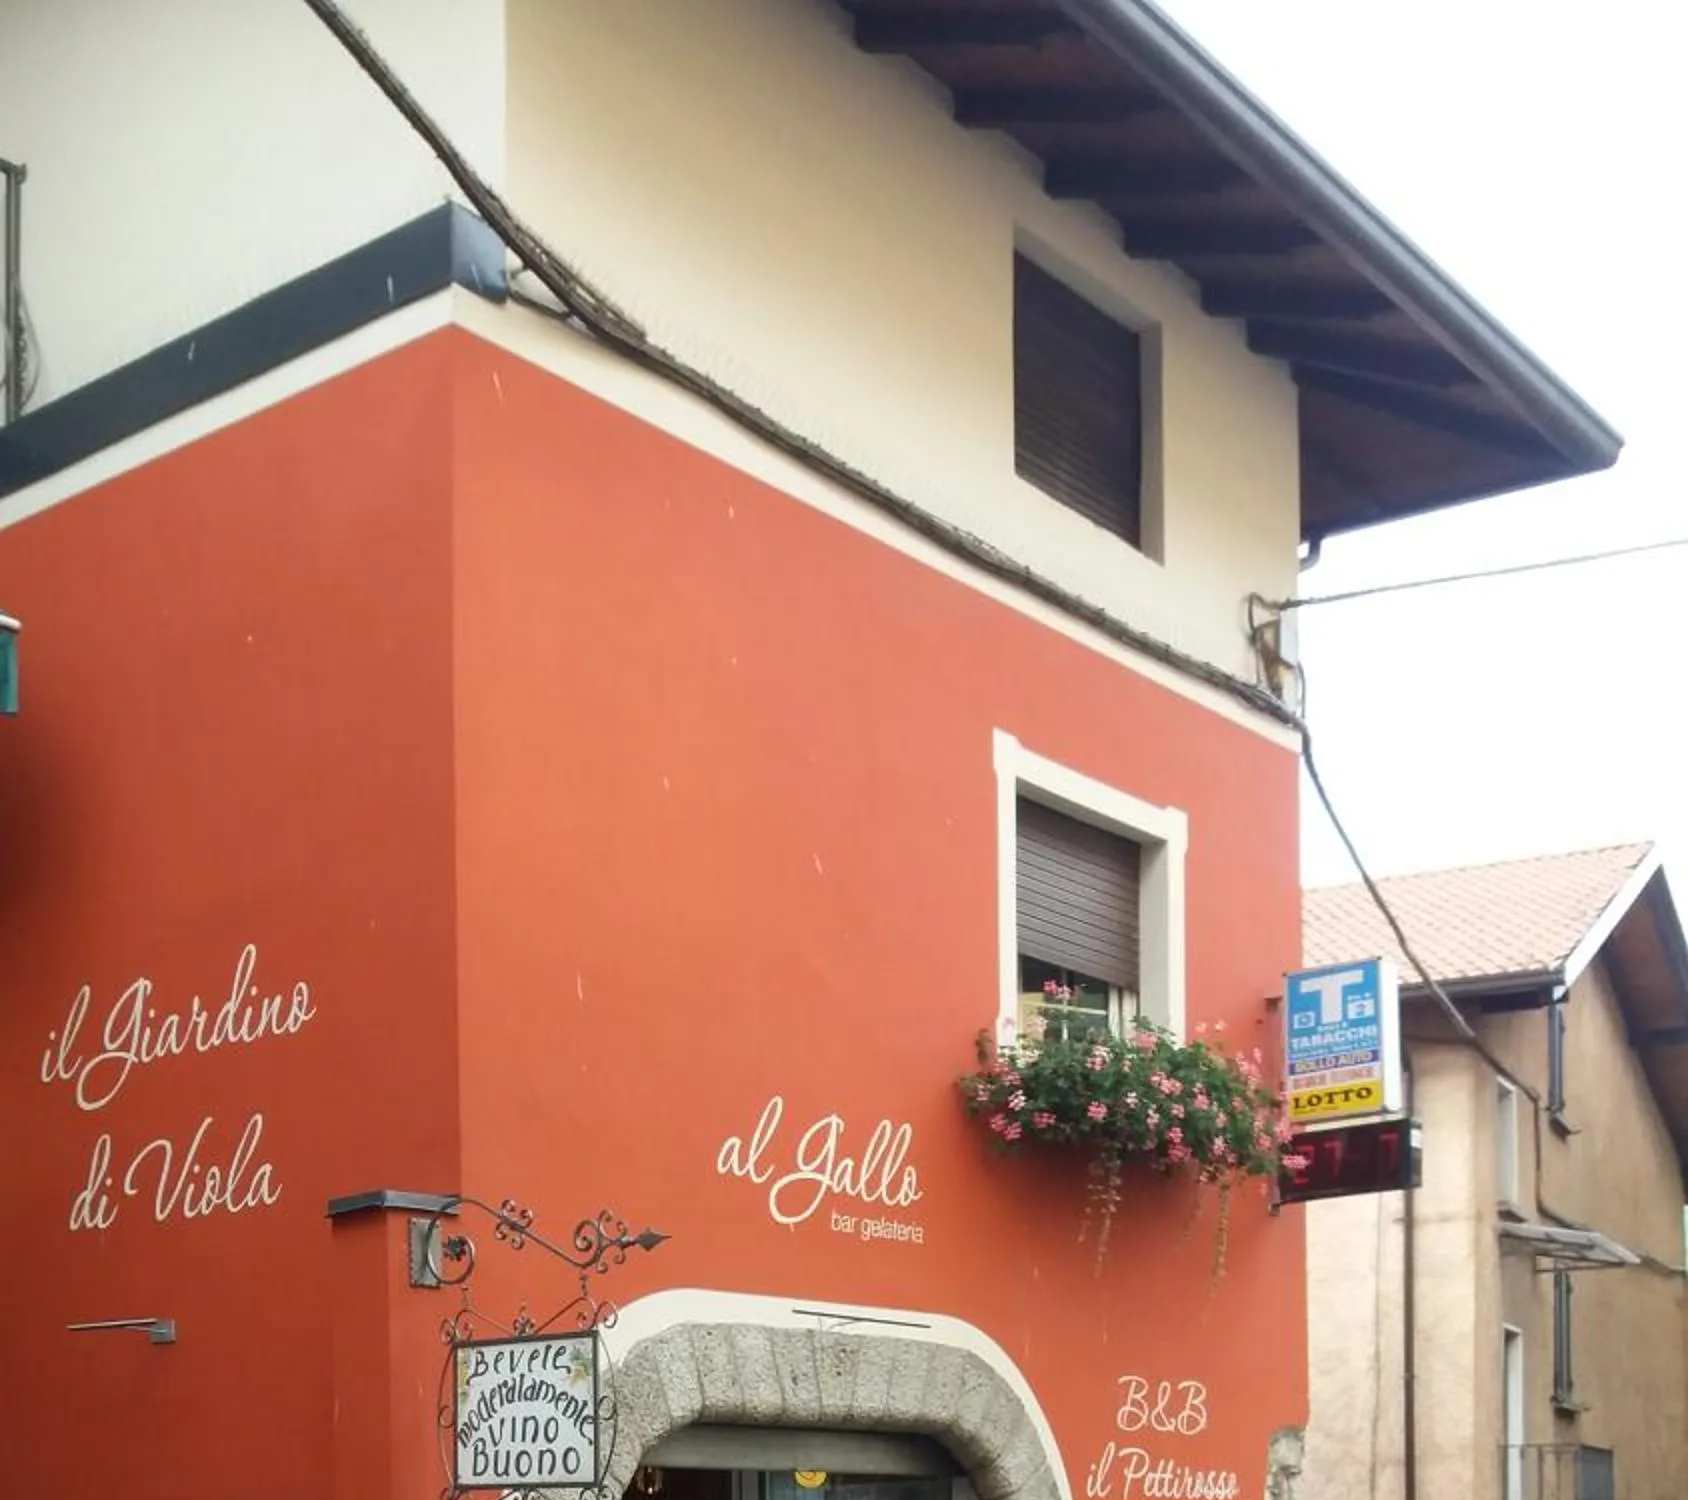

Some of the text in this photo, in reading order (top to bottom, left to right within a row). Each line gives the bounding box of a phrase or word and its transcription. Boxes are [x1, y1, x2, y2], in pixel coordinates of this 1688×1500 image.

[40, 943, 316, 1111] il Giardino
[1291, 1024, 1377, 1052] TABACCHI
[1293, 1087, 1374, 1110] LOTTO
[69, 1112, 283, 1232] di Viola
[716, 1095, 924, 1225] al Gallo
[831, 1210, 924, 1244] bar gelateria
[1117, 1375, 1208, 1436] B&B
[1086, 1441, 1117, 1499] il
